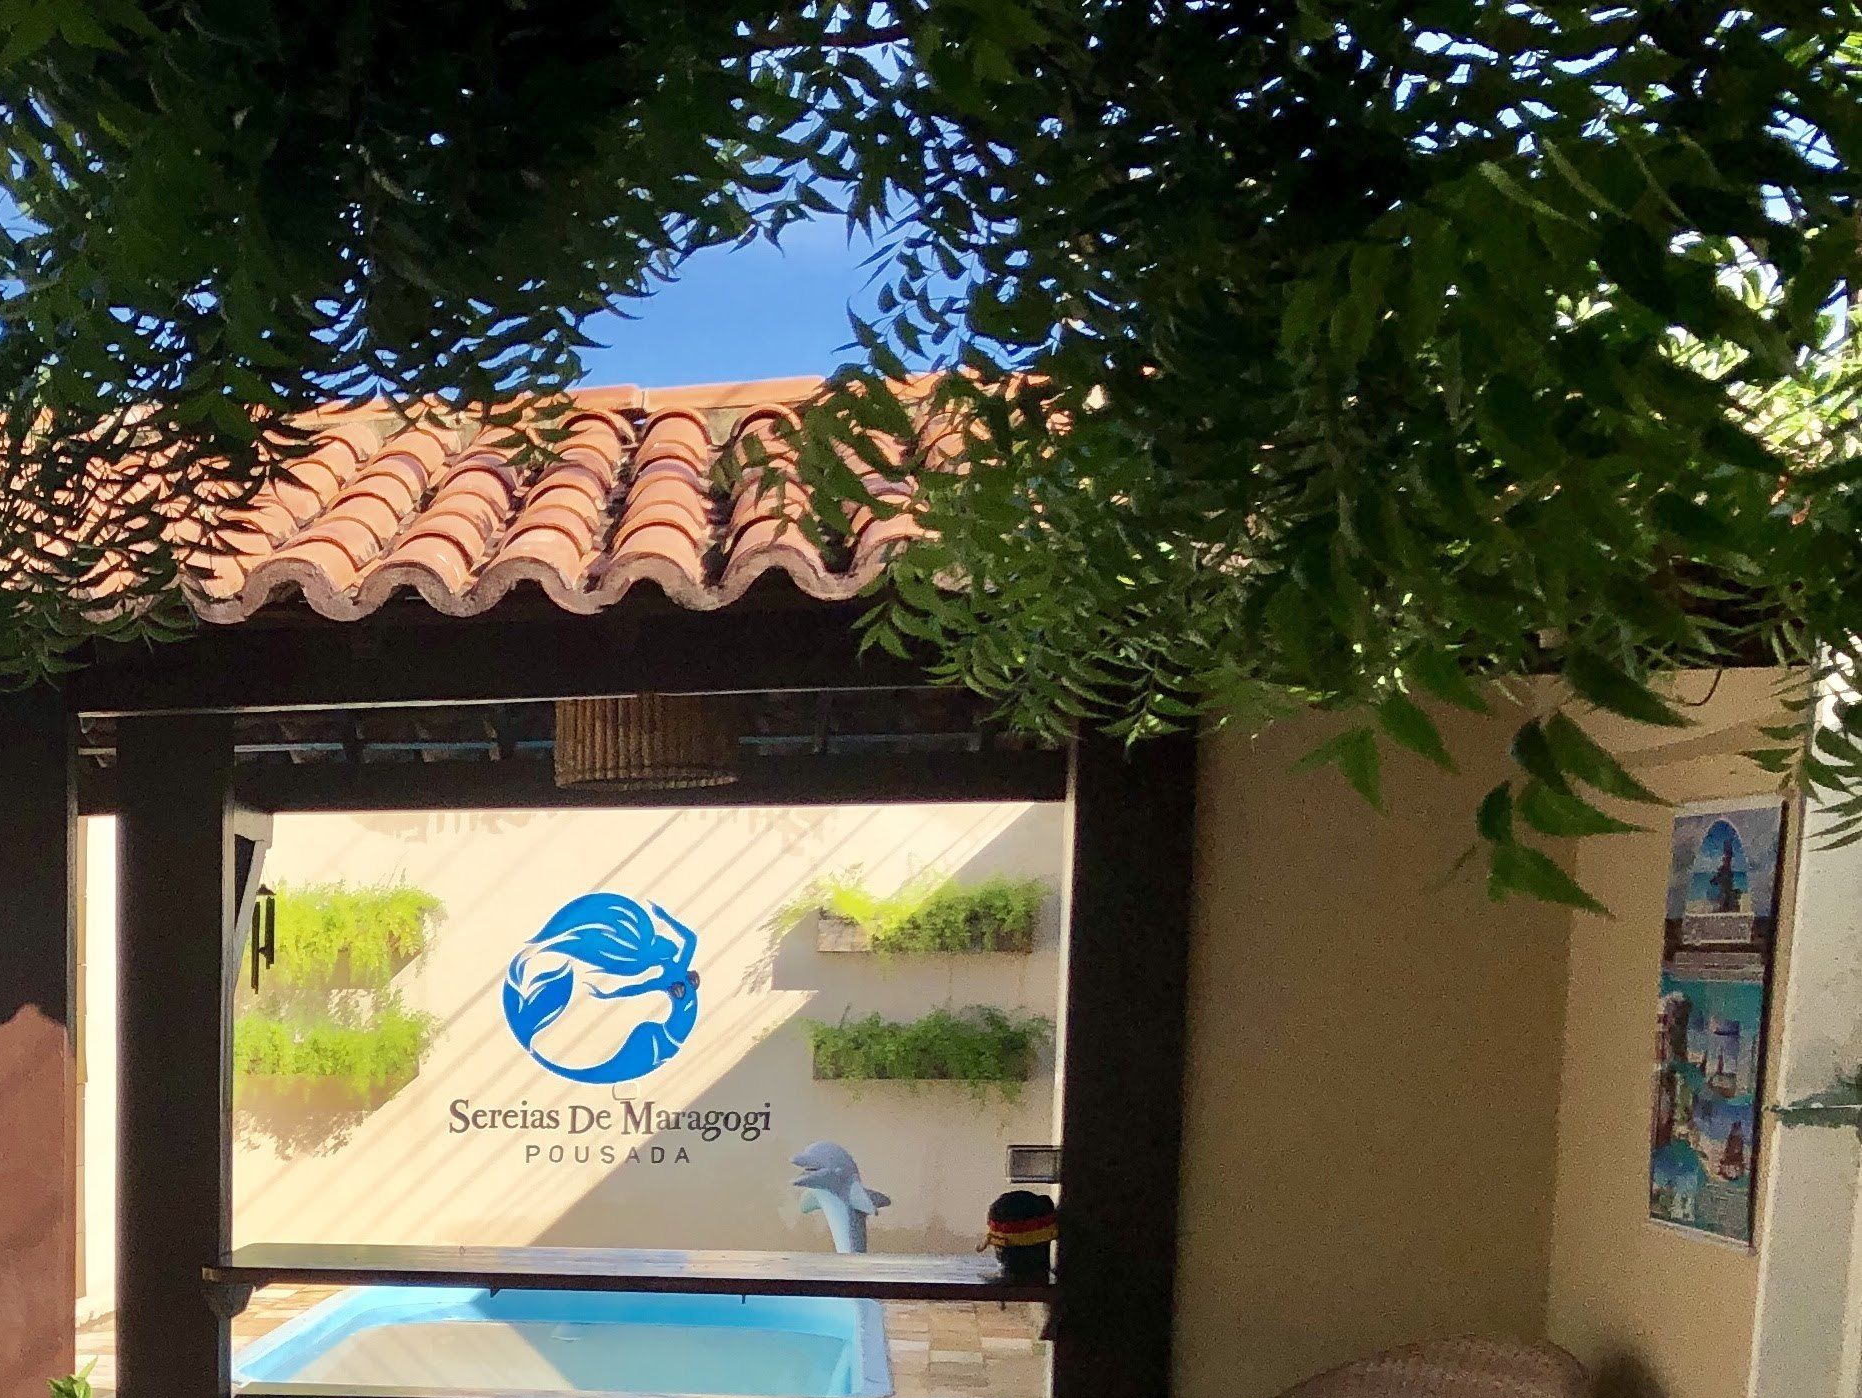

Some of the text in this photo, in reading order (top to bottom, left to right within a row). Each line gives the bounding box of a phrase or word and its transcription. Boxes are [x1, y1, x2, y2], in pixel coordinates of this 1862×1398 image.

[449, 1099, 771, 1141] Sereias De Maragogi
[525, 1144, 691, 1164] POUSADA
